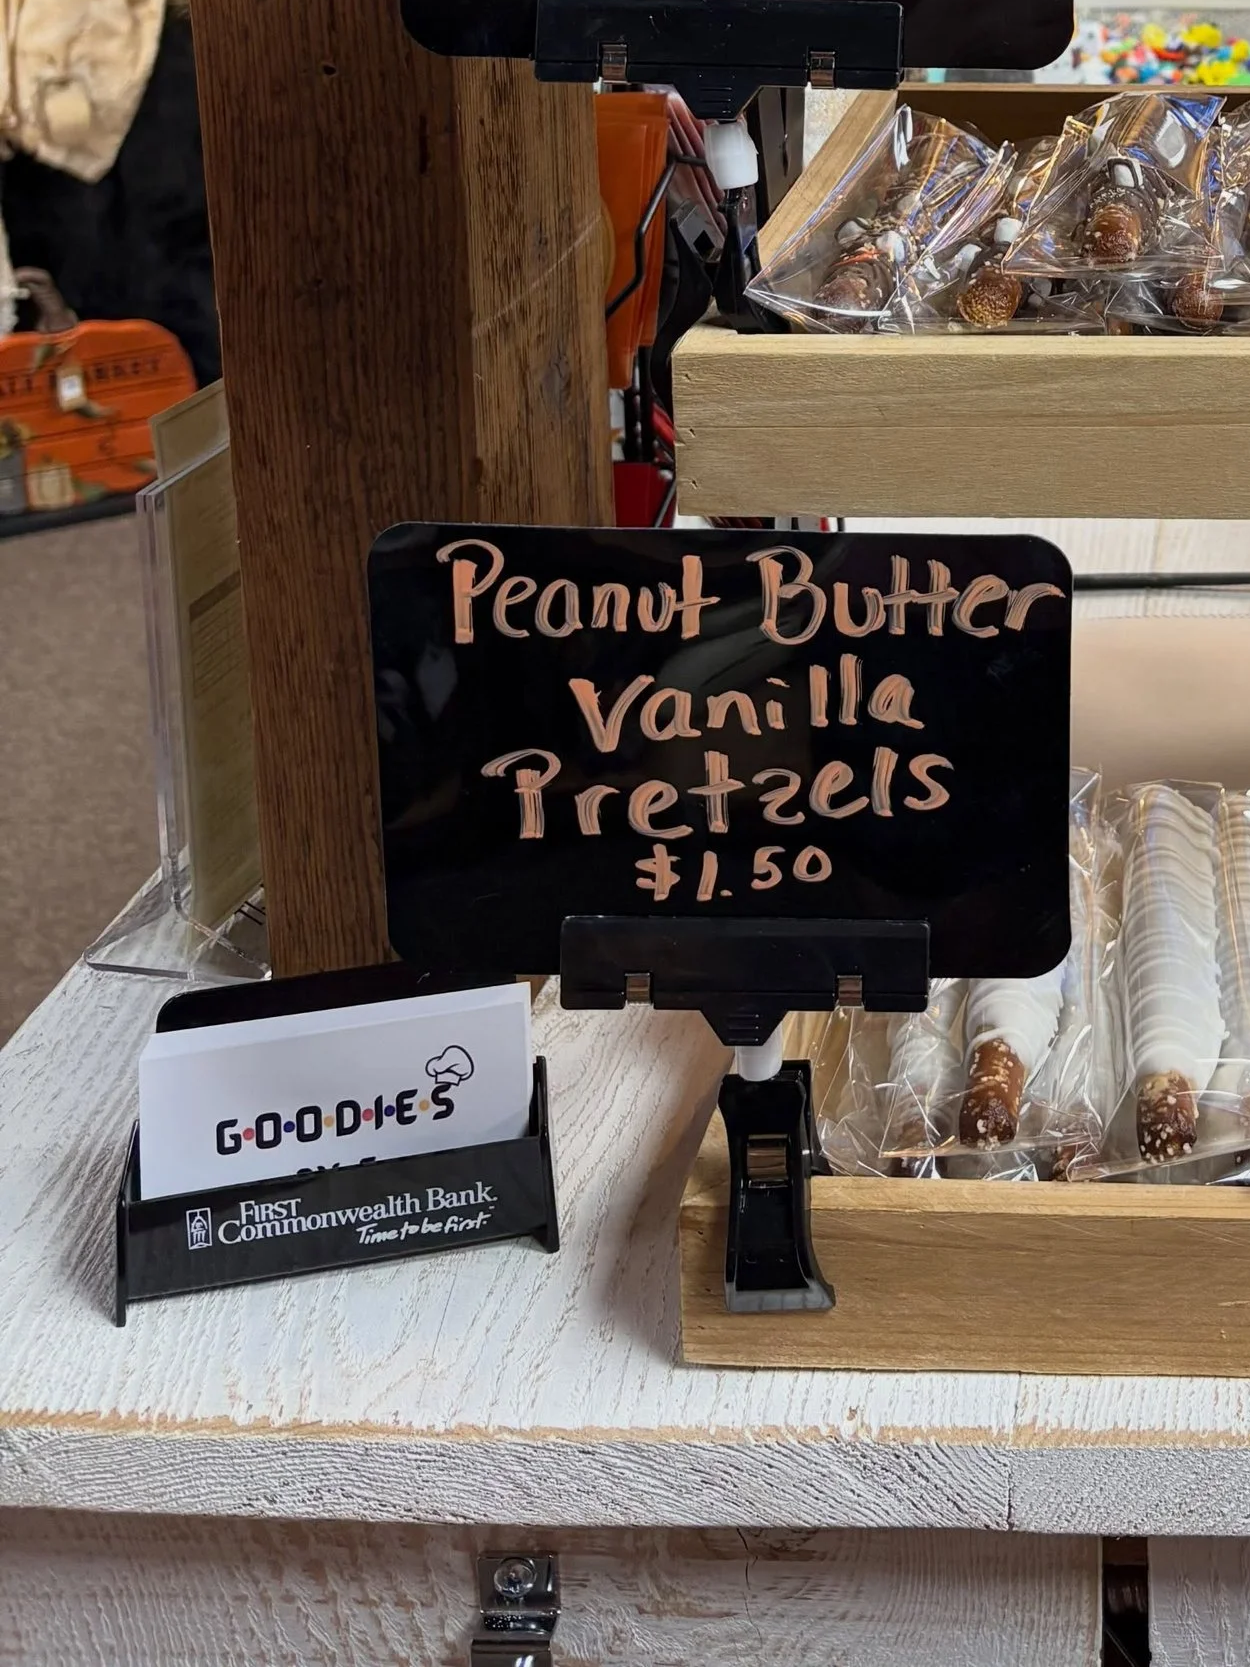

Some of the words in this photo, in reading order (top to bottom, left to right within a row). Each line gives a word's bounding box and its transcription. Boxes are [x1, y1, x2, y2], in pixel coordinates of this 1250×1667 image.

[436, 538, 722, 644] Peanut
[745, 545, 1066, 646] Butter
[568, 653, 925, 753] Vanilla
[480, 746, 954, 840] Pretzels
[635, 843, 833, 902] $1.50
[217, 1192, 422, 1245] Commonwealth
[239, 1198, 302, 1225] FIRST
[356, 1222, 399, 1245] Time
[400, 1221, 420, 1241] to
[421, 1217, 443, 1234] be
